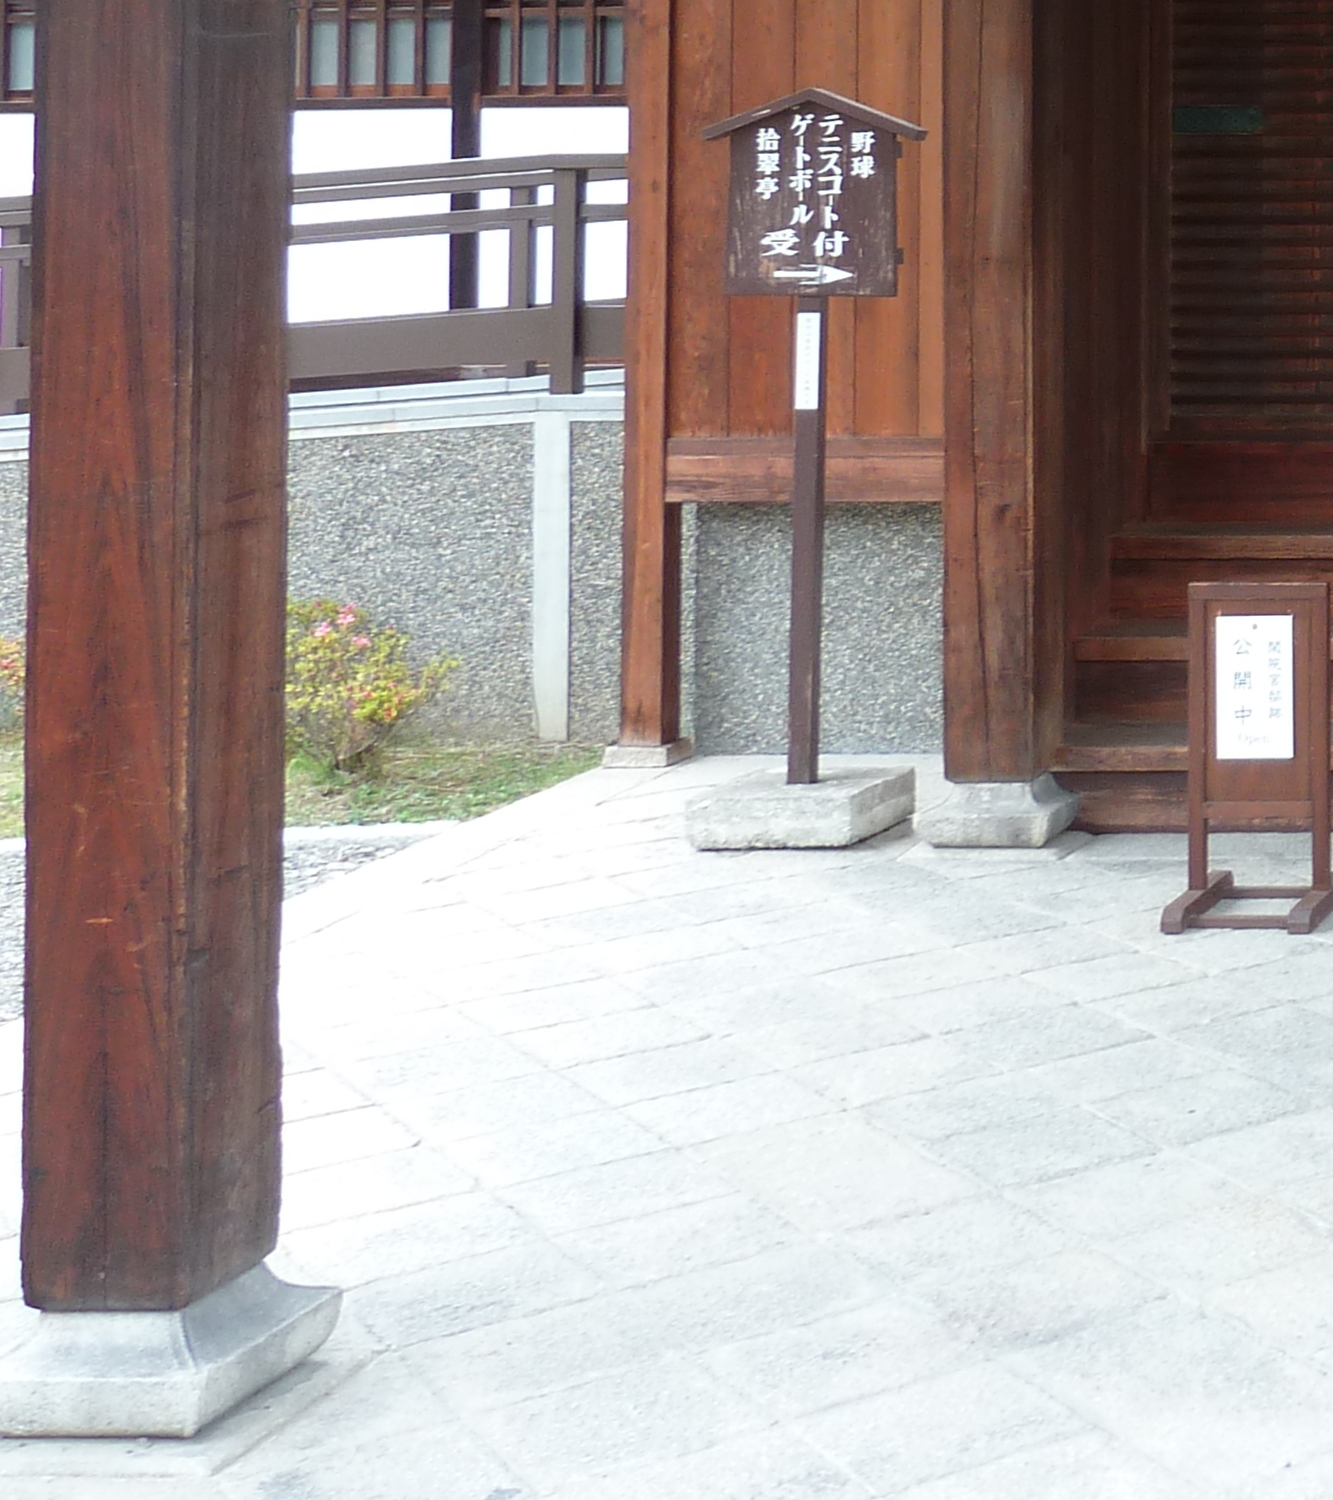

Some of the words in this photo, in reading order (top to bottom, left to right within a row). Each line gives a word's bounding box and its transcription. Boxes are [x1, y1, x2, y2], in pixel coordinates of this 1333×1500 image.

[755, 128, 781, 200] 拾翠亭
[789, 113, 815, 225] ゲートボール
[817, 114, 844, 229] テニスコート
[850, 131, 876, 178] 野球
[760, 228, 849, 257] 受付
[1233, 637, 1253, 725] 公開中
